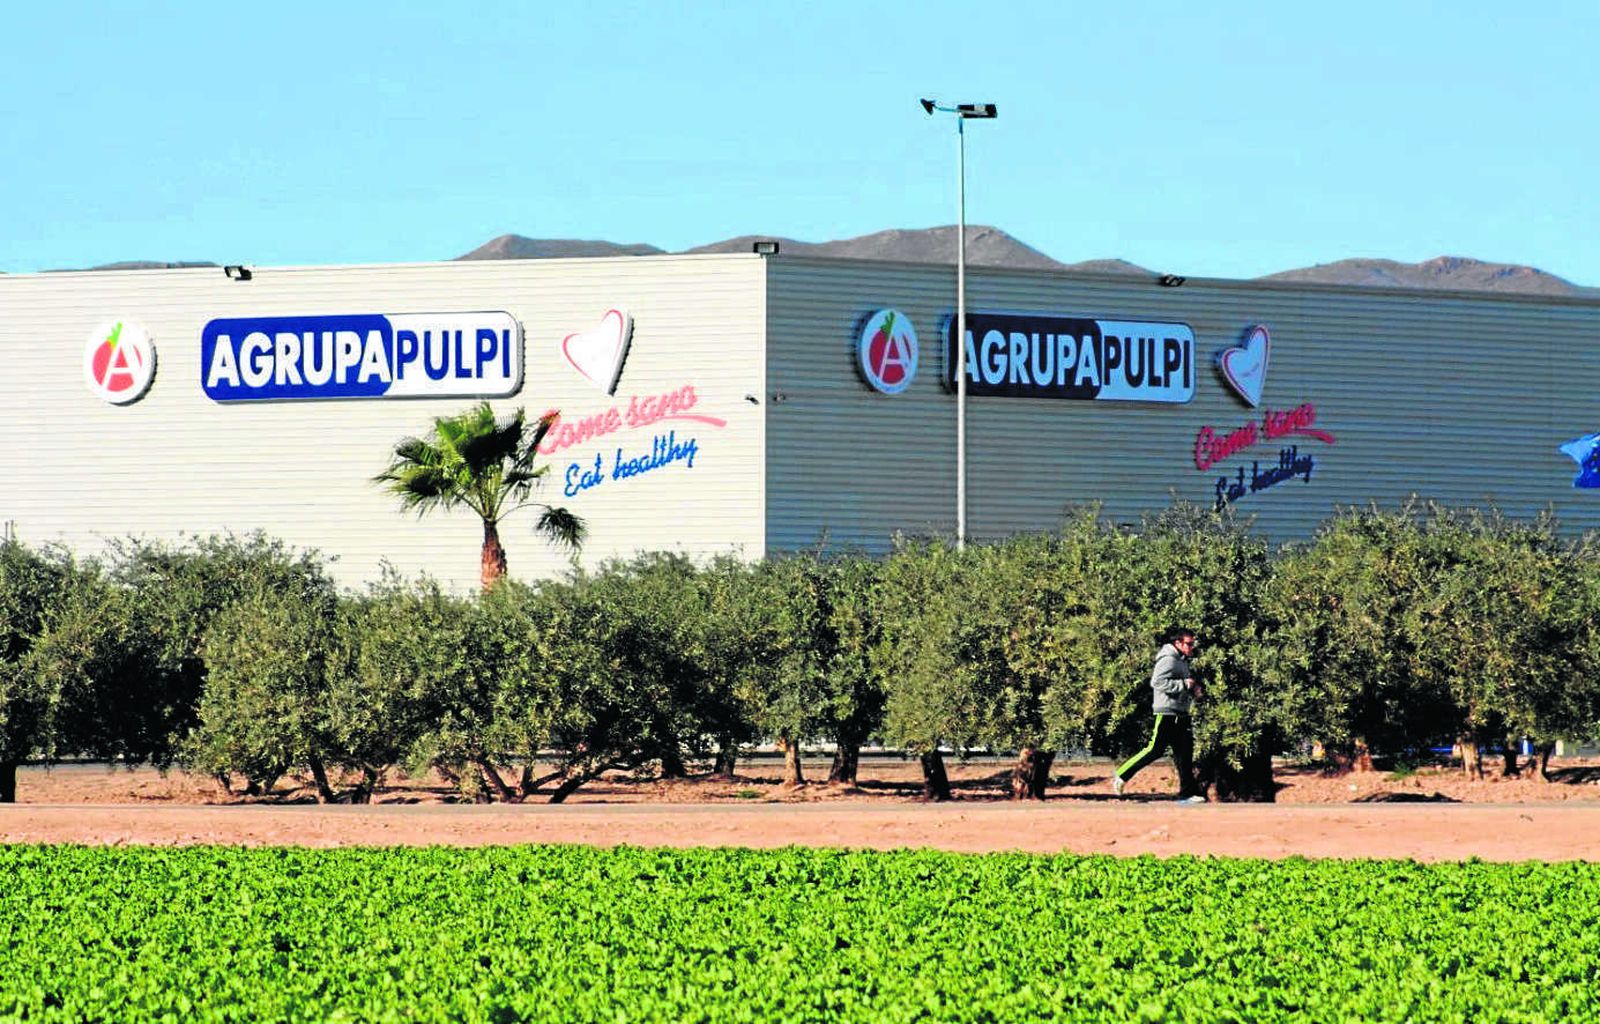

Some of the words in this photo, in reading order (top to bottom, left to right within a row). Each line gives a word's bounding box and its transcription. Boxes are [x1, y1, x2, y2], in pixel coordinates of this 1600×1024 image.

[536, 409, 622, 455] Come
[625, 384, 698, 428] sano
[564, 452, 604, 497] Eat
[612, 430, 698, 481] healthy
